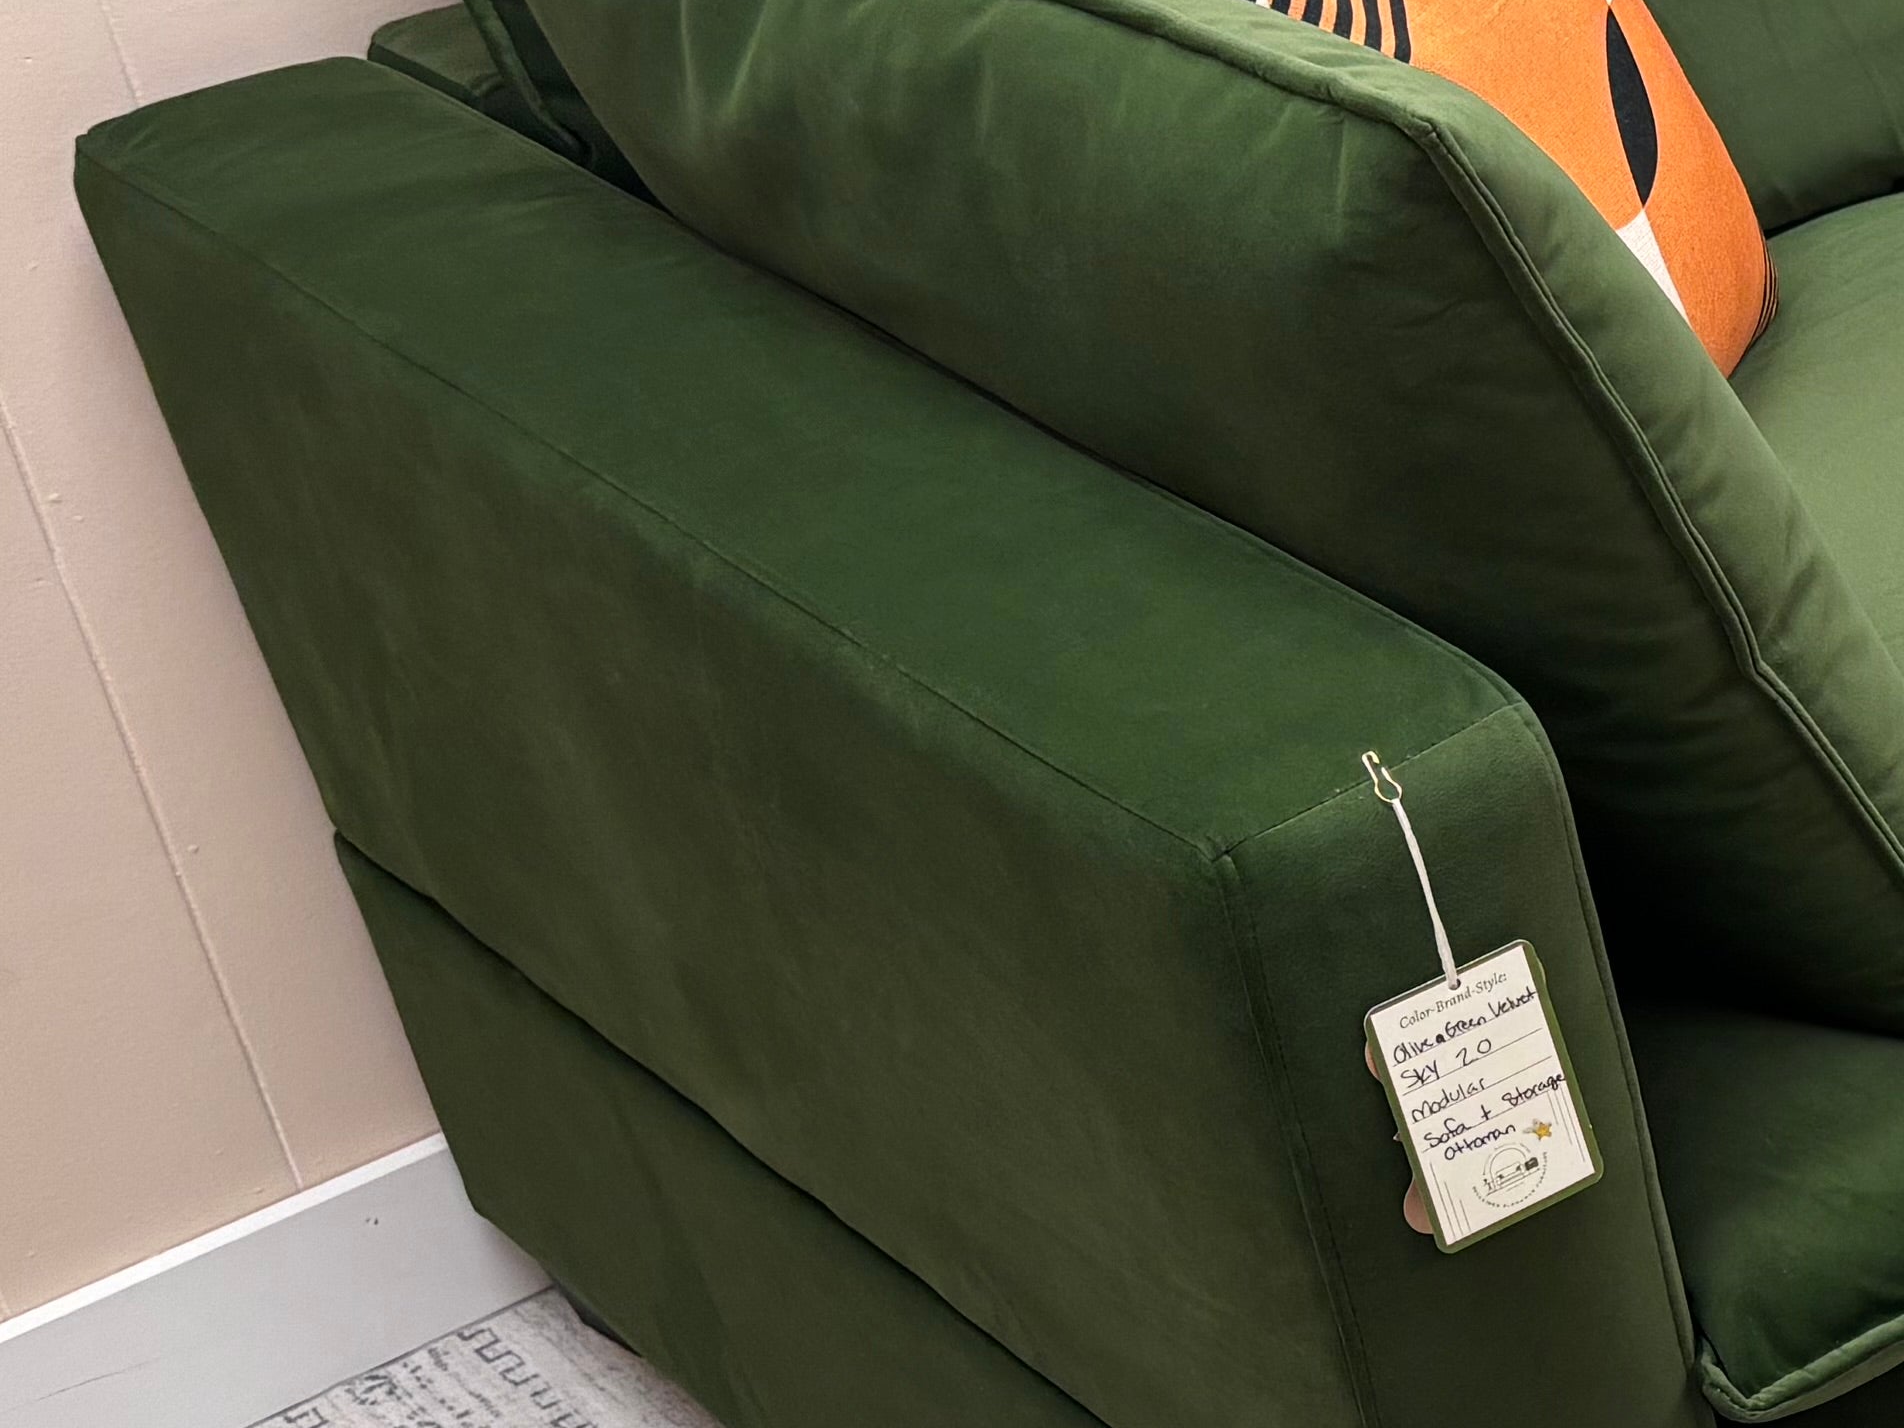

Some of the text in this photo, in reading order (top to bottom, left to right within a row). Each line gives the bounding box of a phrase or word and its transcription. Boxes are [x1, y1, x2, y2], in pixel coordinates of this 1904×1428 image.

[1393, 986, 1538, 1065] Olive Green Velvet
[1423, 1118, 1470, 1149] Sofa
